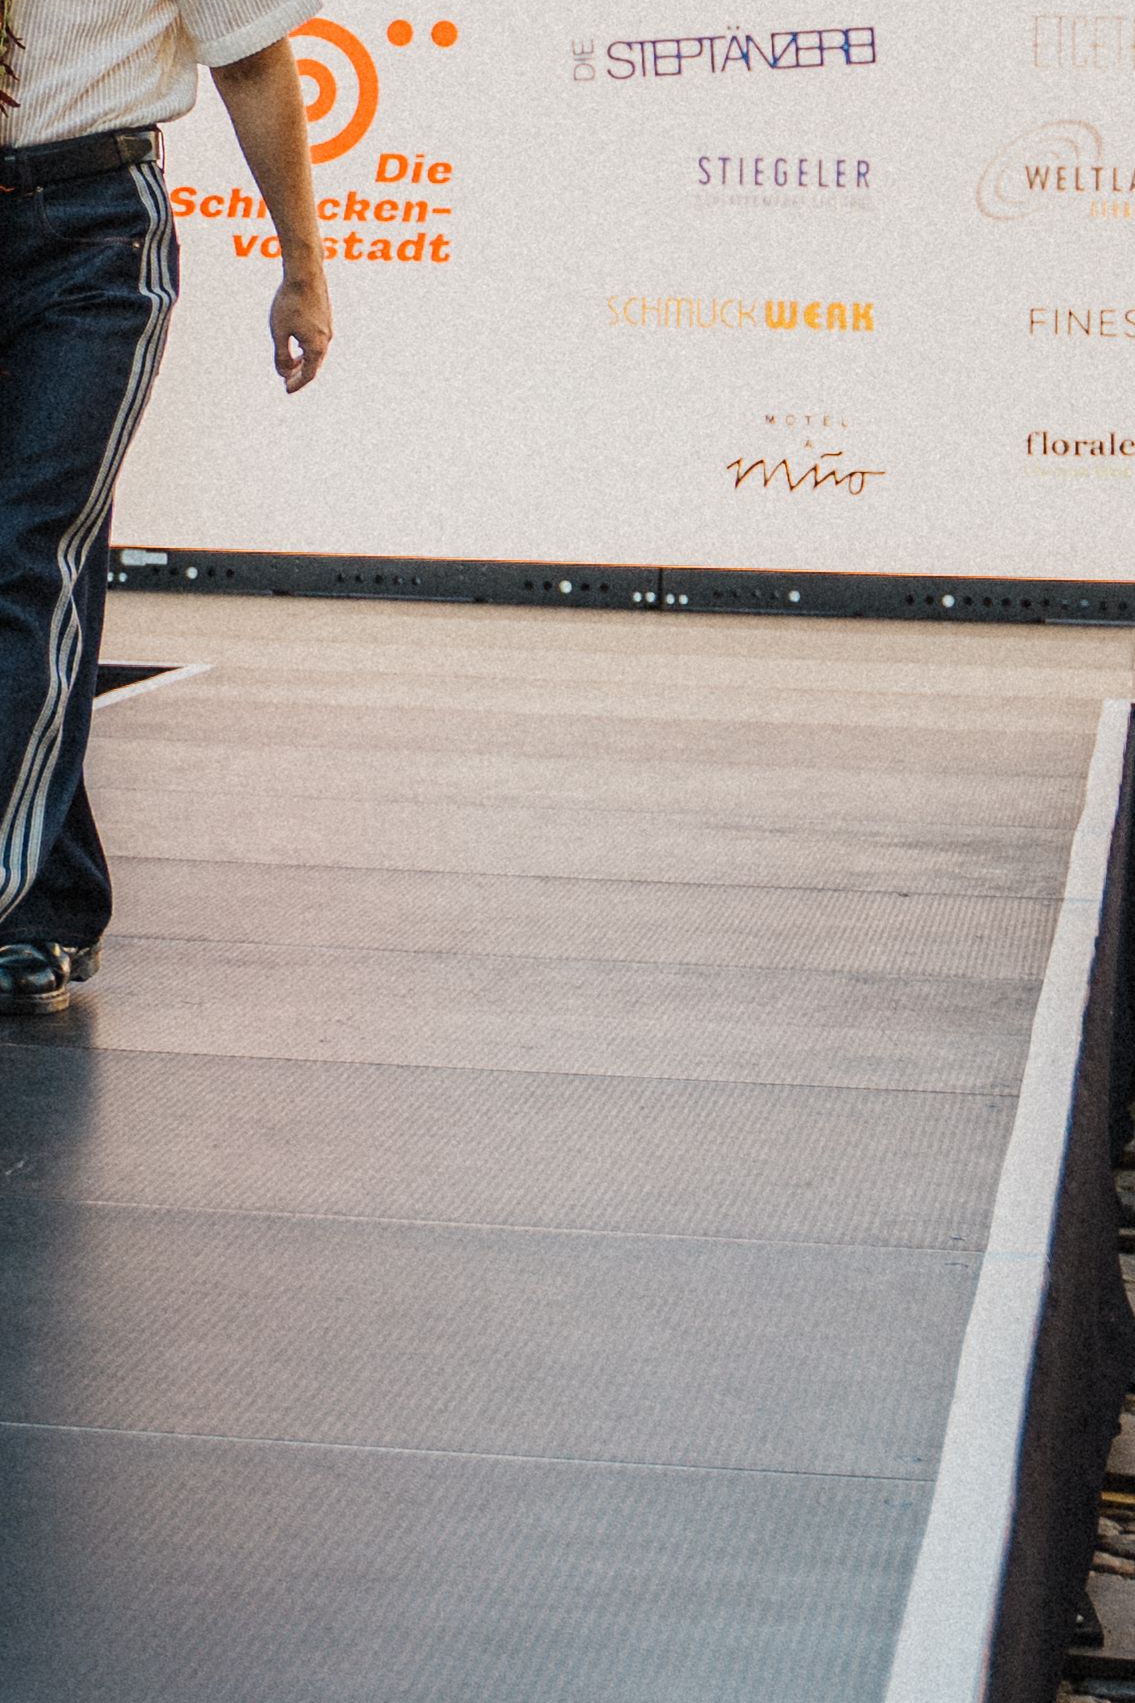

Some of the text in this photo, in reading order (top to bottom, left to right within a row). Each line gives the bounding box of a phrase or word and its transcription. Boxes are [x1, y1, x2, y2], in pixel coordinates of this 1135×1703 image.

[572, 38, 596, 81] DIE
[375, 152, 453, 184] Die
[698, 155, 870, 189] STIEGELER
[169, 186, 453, 224] Schcken-
[232, 231, 452, 263] vostadt
[765, 414, 849, 428] MOTEL
